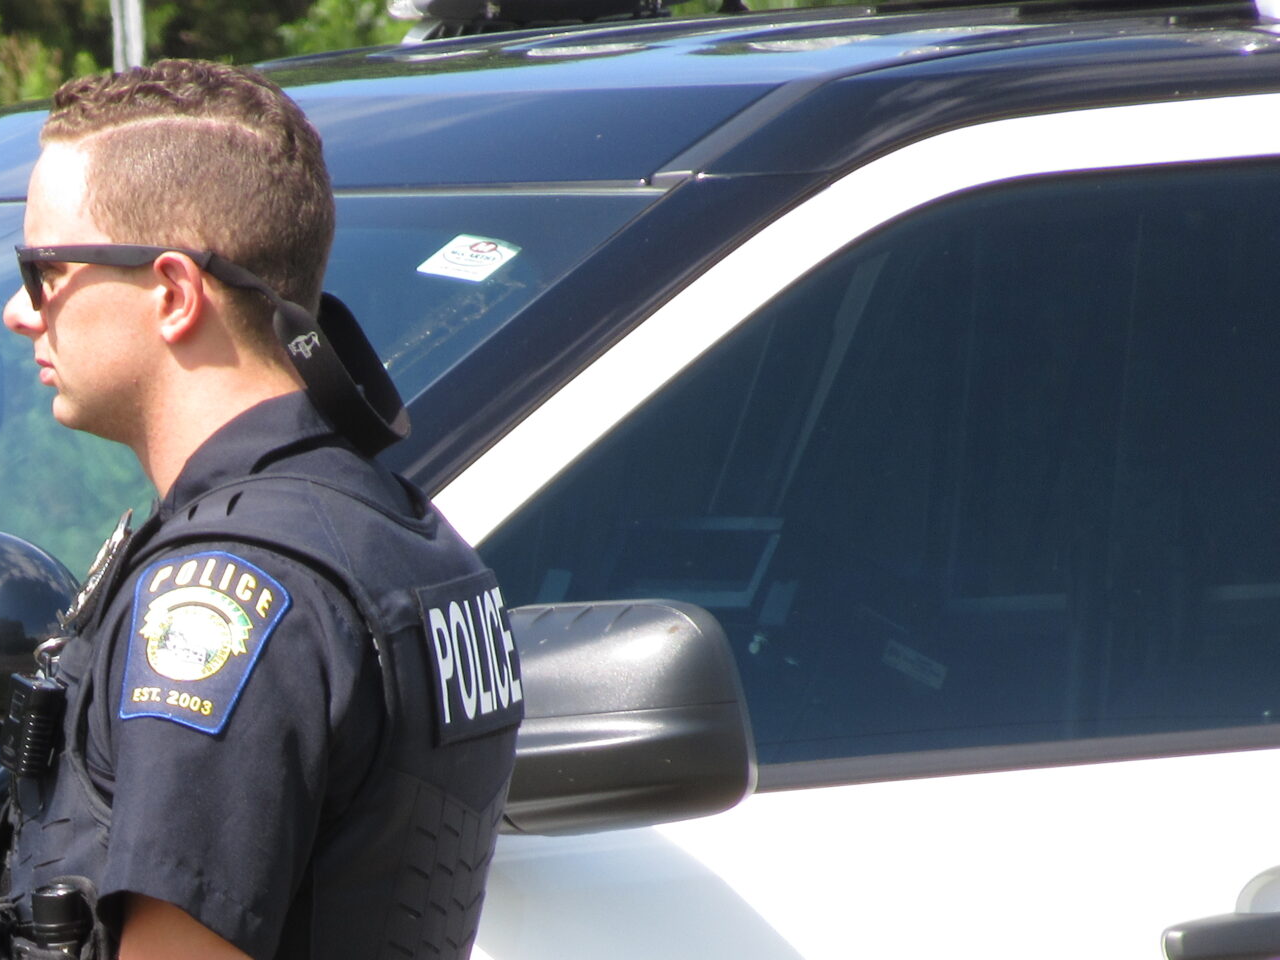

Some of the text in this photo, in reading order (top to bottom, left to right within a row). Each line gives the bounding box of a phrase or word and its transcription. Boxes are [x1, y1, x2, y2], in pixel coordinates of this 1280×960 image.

[149, 558, 273, 619] POLICE
[429, 586, 522, 724] POLICE
[132, 687, 213, 716] EST. 2003
